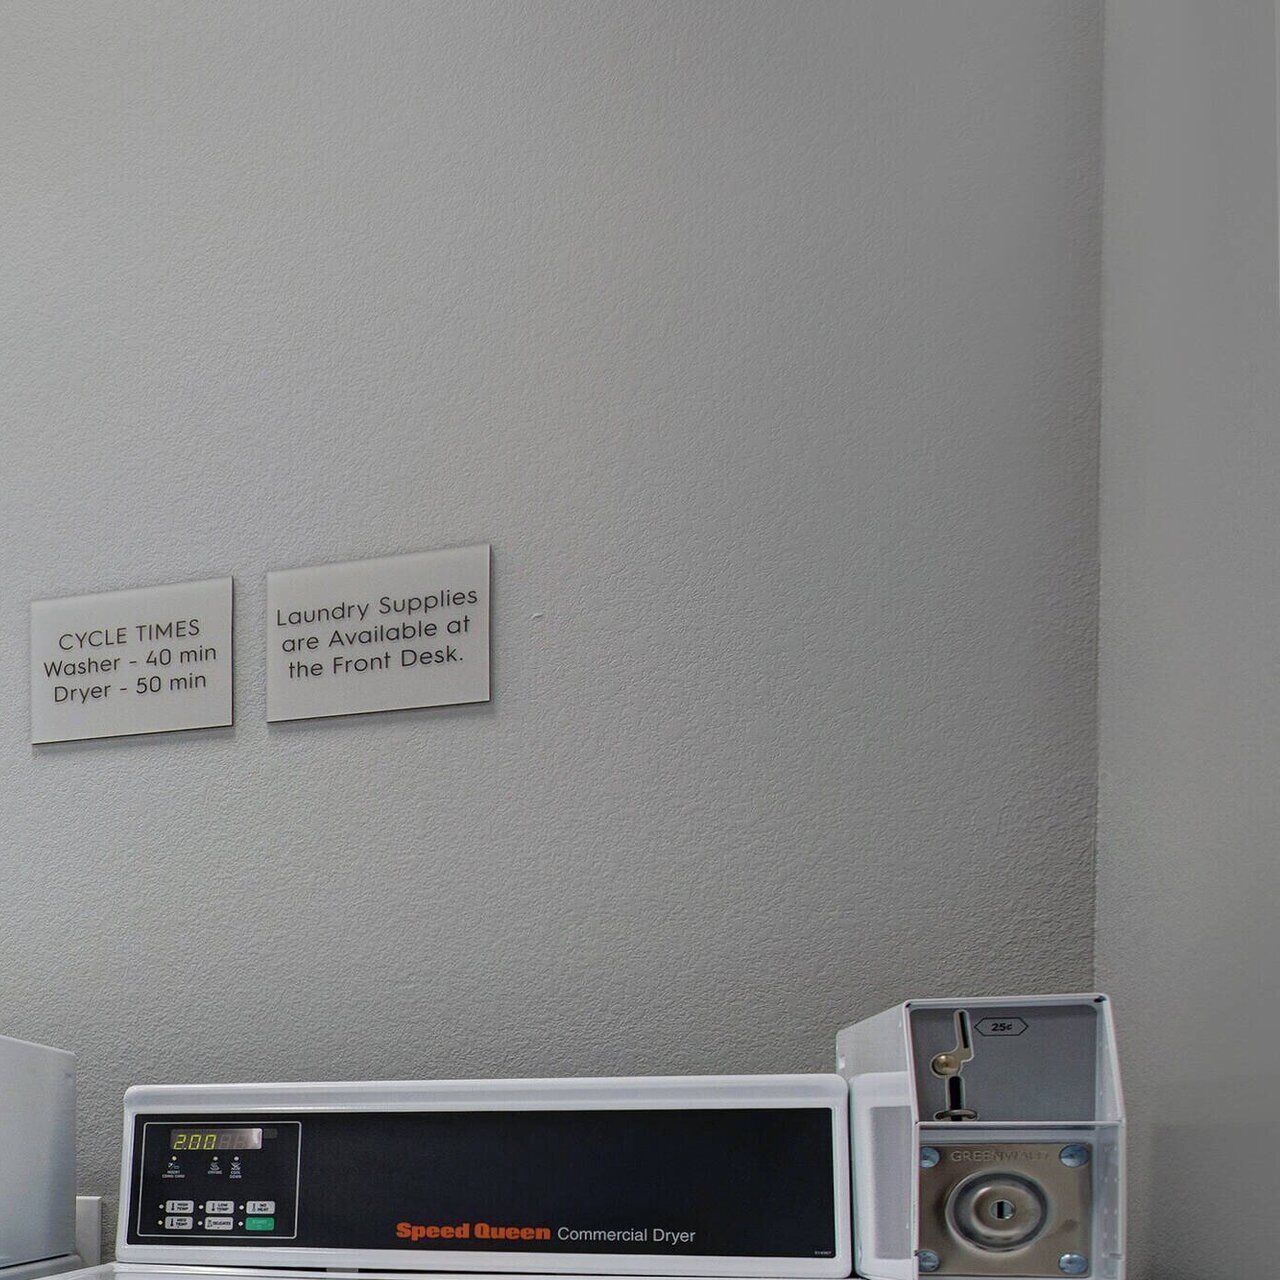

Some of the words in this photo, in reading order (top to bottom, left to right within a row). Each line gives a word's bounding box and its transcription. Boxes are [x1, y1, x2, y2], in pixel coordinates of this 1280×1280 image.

[276, 601, 370, 627] Laundry
[378, 589, 478, 616] Supplies
[59, 627, 128, 651] CYCLE
[135, 619, 201, 642] TIMES
[281, 636, 320, 653] are
[328, 620, 438, 648] Available
[446, 615, 471, 634] at
[43, 657, 121, 678] Washer
[146, 648, 172, 667] 40
[179, 644, 217, 664] min
[288, 661, 324, 679] the
[332, 651, 392, 674] Front
[401, 645, 464, 667] Desk.
[54, 684, 112, 704] Dryer
[136, 675, 162, 695] 50
[170, 672, 207, 691] min
[991, 1022, 1013, 1032] 25¢
[395, 1222, 471, 1242] Speed
[474, 1222, 552, 1240] Queen
[557, 1227, 648, 1242] Commercial
[653, 1228, 696, 1245] Dryer
